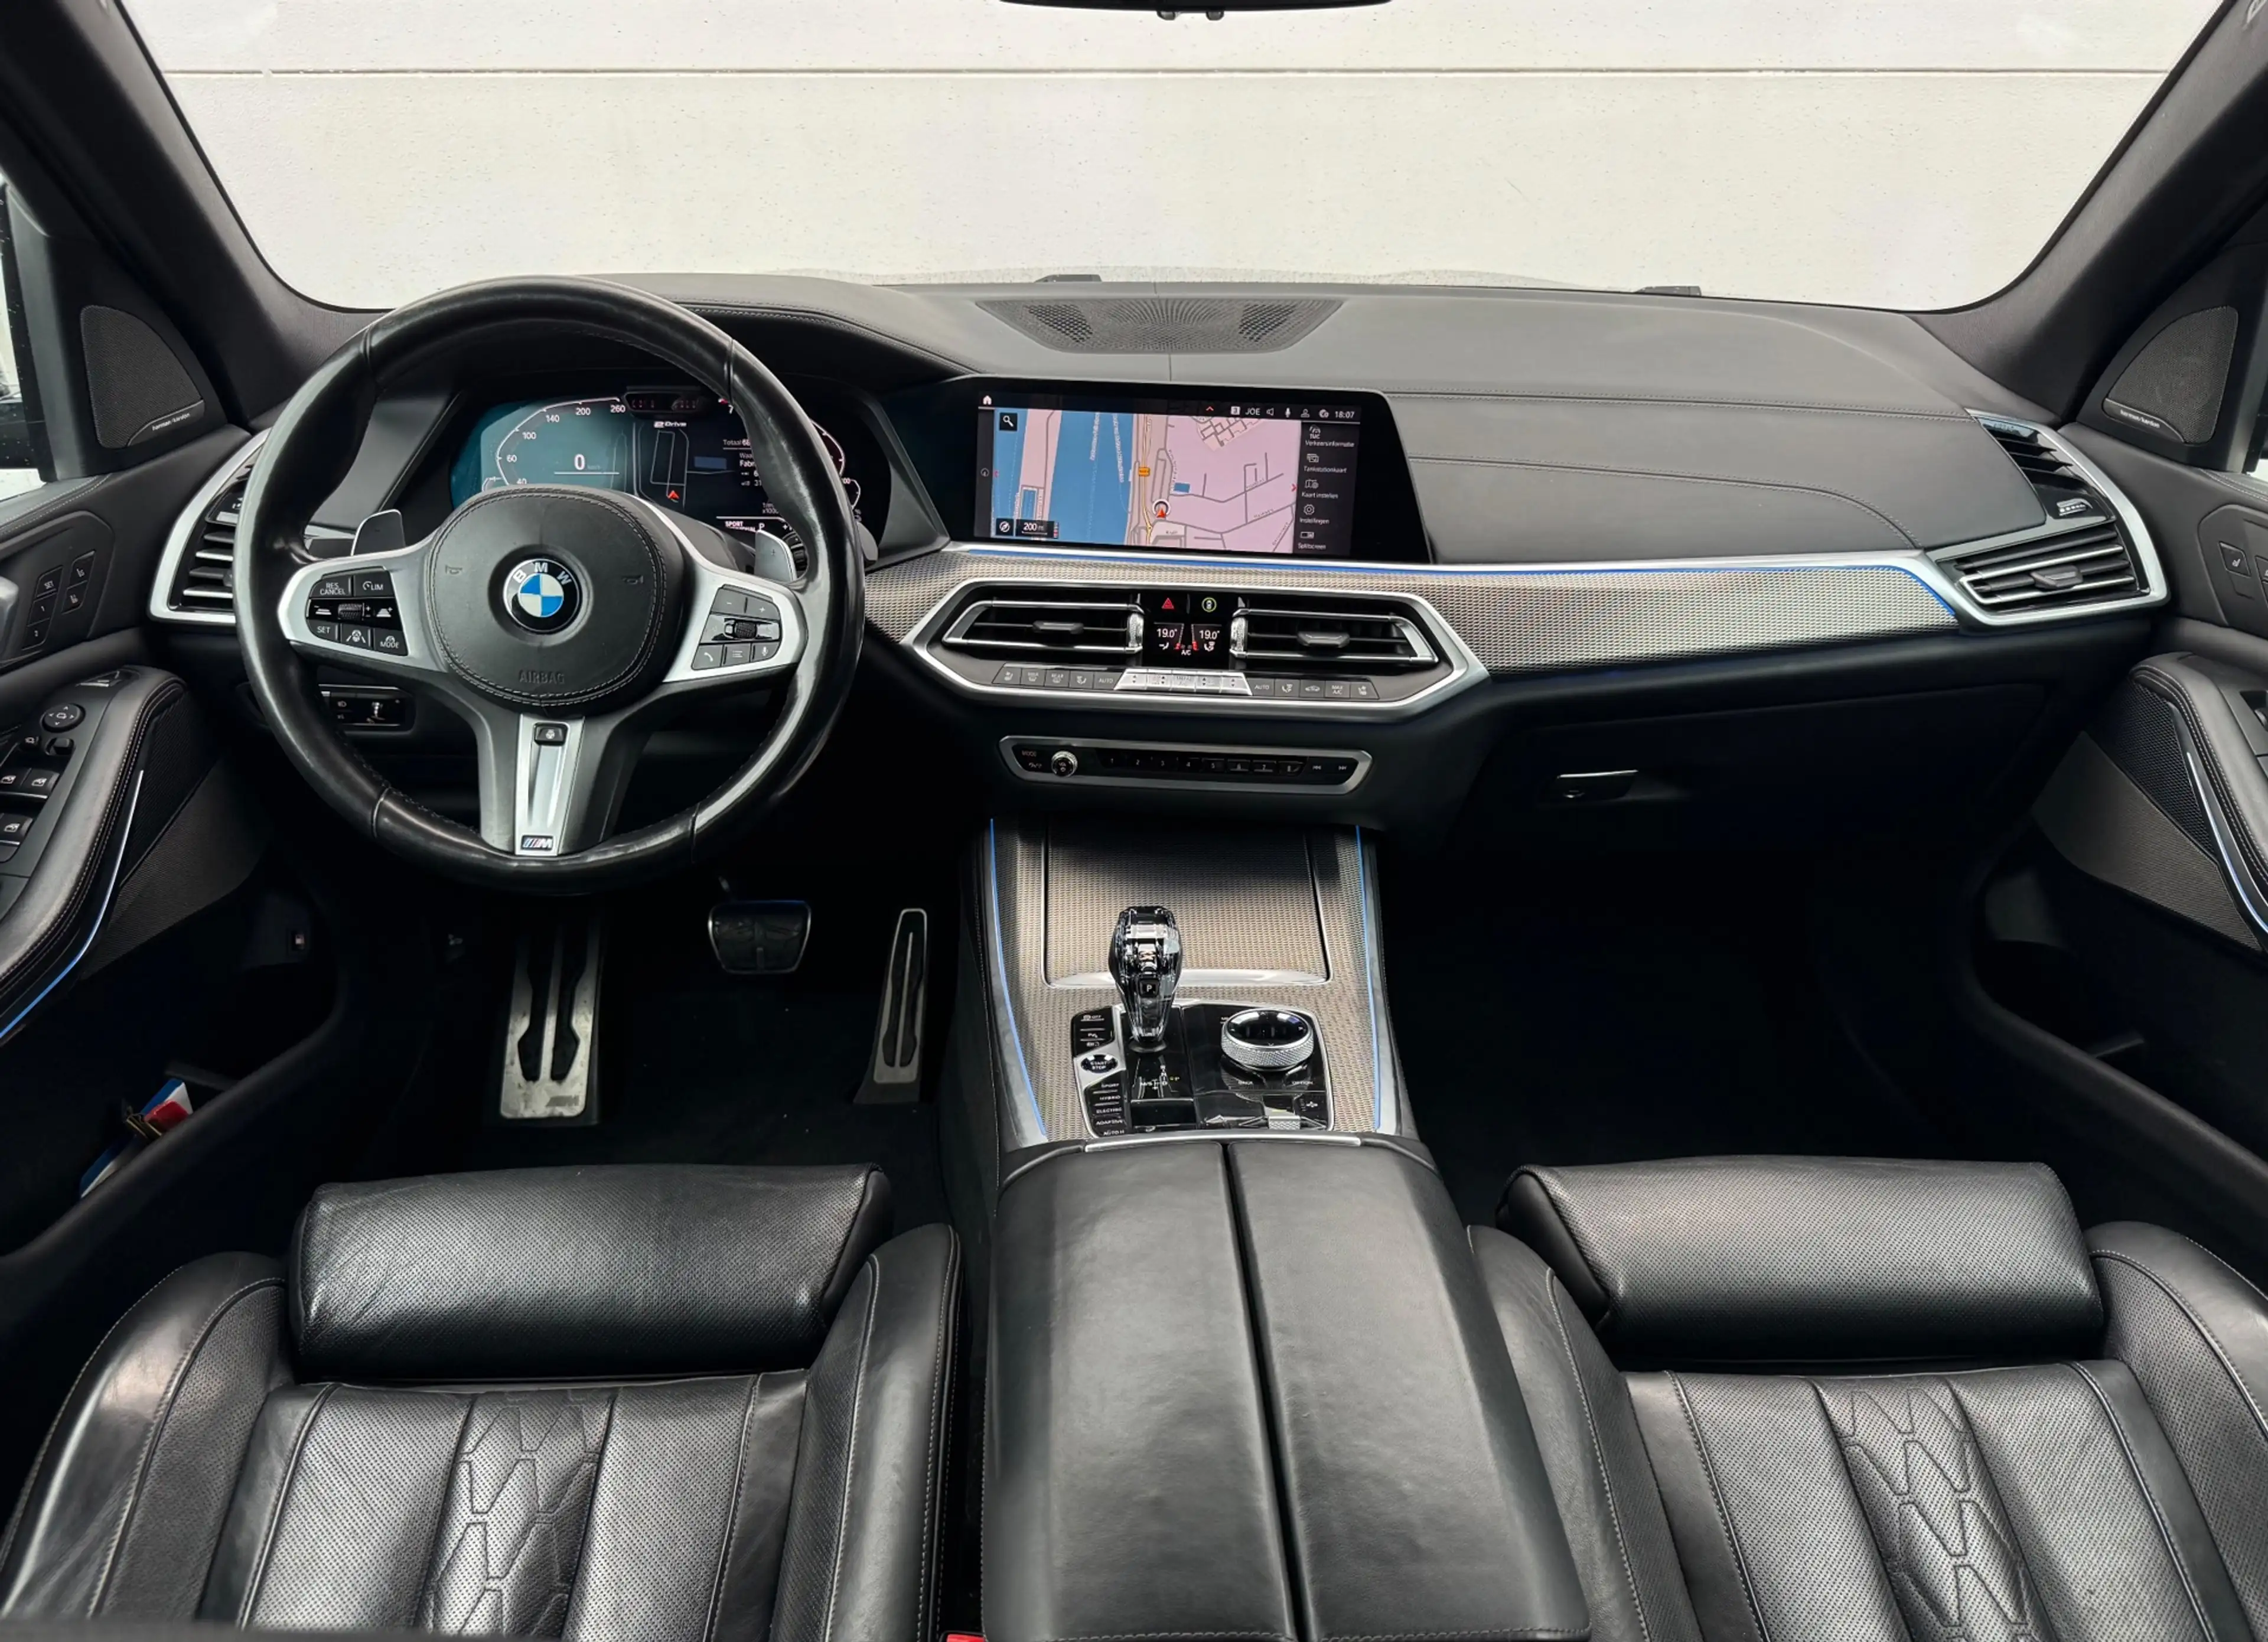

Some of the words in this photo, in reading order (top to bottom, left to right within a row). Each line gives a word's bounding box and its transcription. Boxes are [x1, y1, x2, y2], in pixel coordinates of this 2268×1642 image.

[576, 407, 591, 416] 200
[610, 404, 626, 413] 260
[728, 404, 734, 414] 7
[546, 415, 560, 423] 140
[522, 432, 536, 440] 100
[1305, 439, 1355, 448] Verkeersinformatie
[506, 454, 517, 463] 60
[574, 453, 585, 470] 0
[1023, 523, 1037, 532] 200
[1298, 542, 1327, 550] Splitscreen
[513, 562, 573, 585] BMW
[43, 580, 54, 589] SET
[320, 588, 346, 596] CANCEL
[317, 625, 331, 634] SET
[380, 640, 399, 649] MODE
[519, 669, 565, 685] AIRBAG
